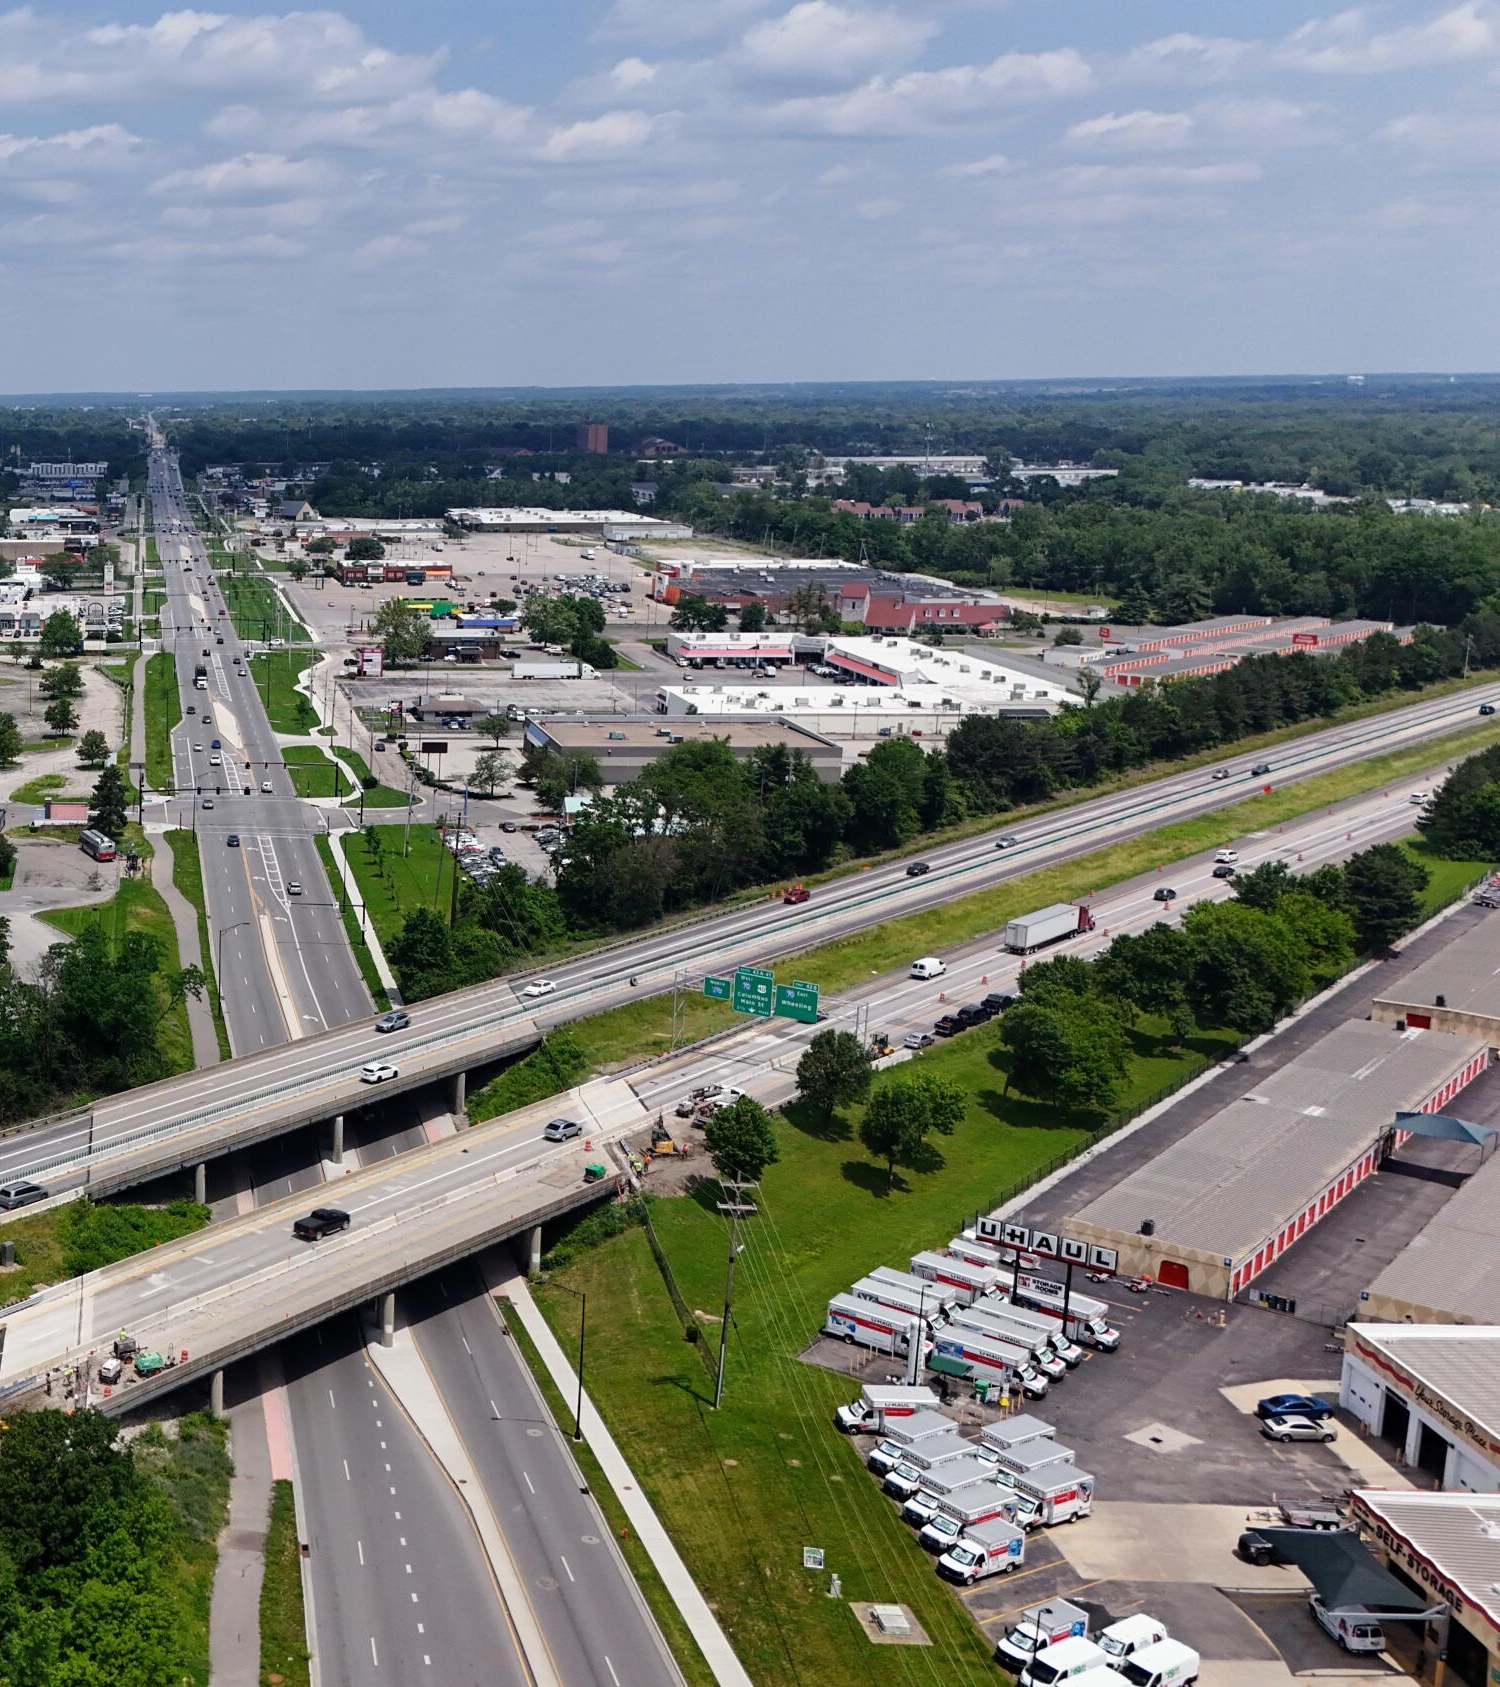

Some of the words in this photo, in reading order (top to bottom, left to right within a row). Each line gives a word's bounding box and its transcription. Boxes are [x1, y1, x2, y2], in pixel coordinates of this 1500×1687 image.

[737, 991, 768, 1002] Columbus
[781, 999, 812, 1011] Wheeling
[1031, 1278, 1062, 1292] STORAGE
[1034, 1284, 1059, 1296] ROOMS
[1414, 1384, 1433, 1408] Your
[1433, 1400, 1463, 1431] Storage
[1465, 1421, 1488, 1450] Place
